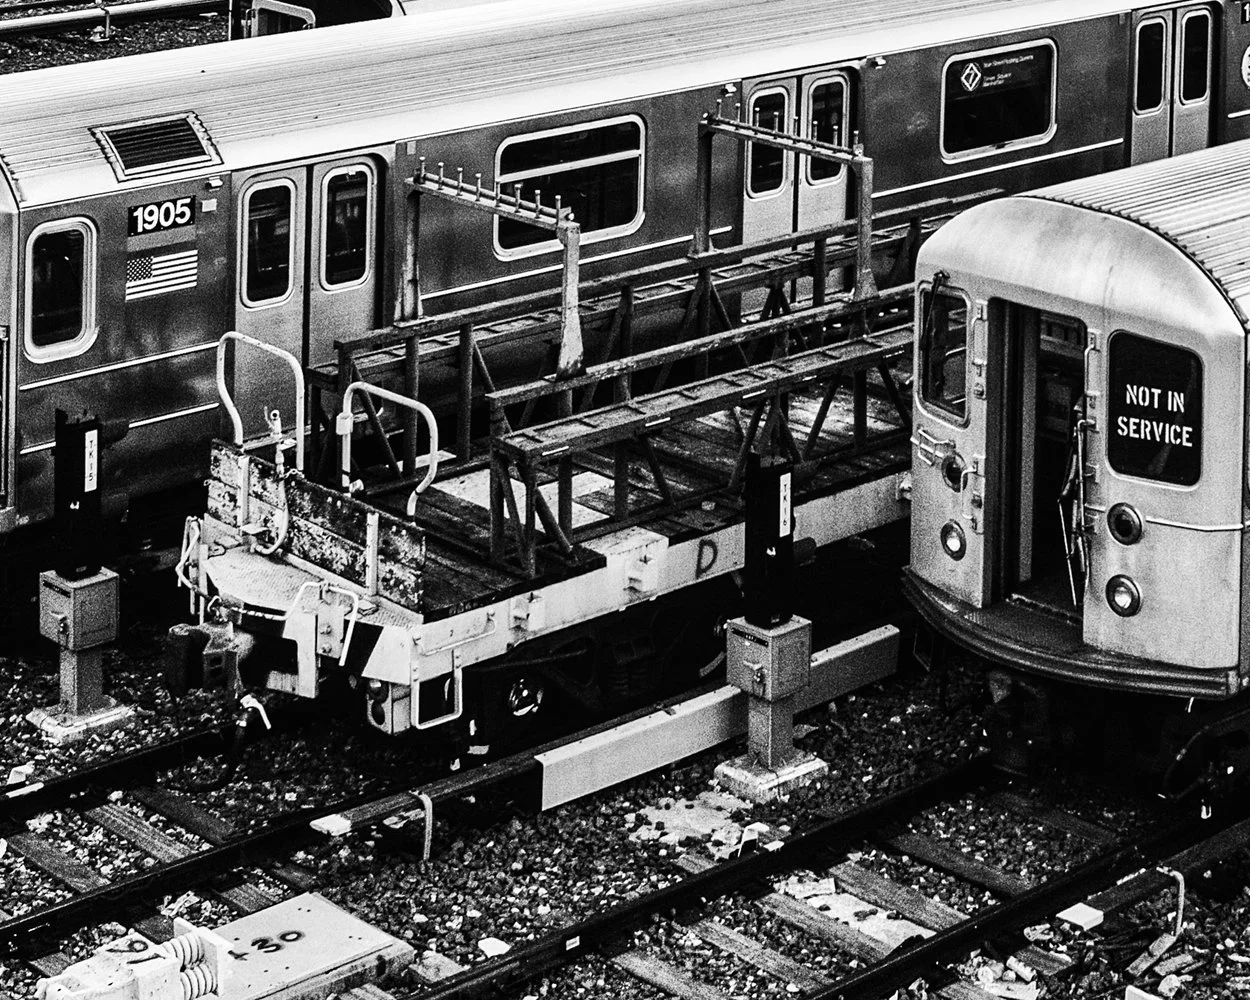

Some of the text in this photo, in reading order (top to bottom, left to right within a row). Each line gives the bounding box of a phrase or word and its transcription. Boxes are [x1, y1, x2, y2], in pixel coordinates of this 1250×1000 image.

[132, 197, 192, 233] 1905
[1126, 384, 1185, 413] NOT IN
[1117, 416, 1193, 447] SERVICE
[695, 539, 718, 580] D
